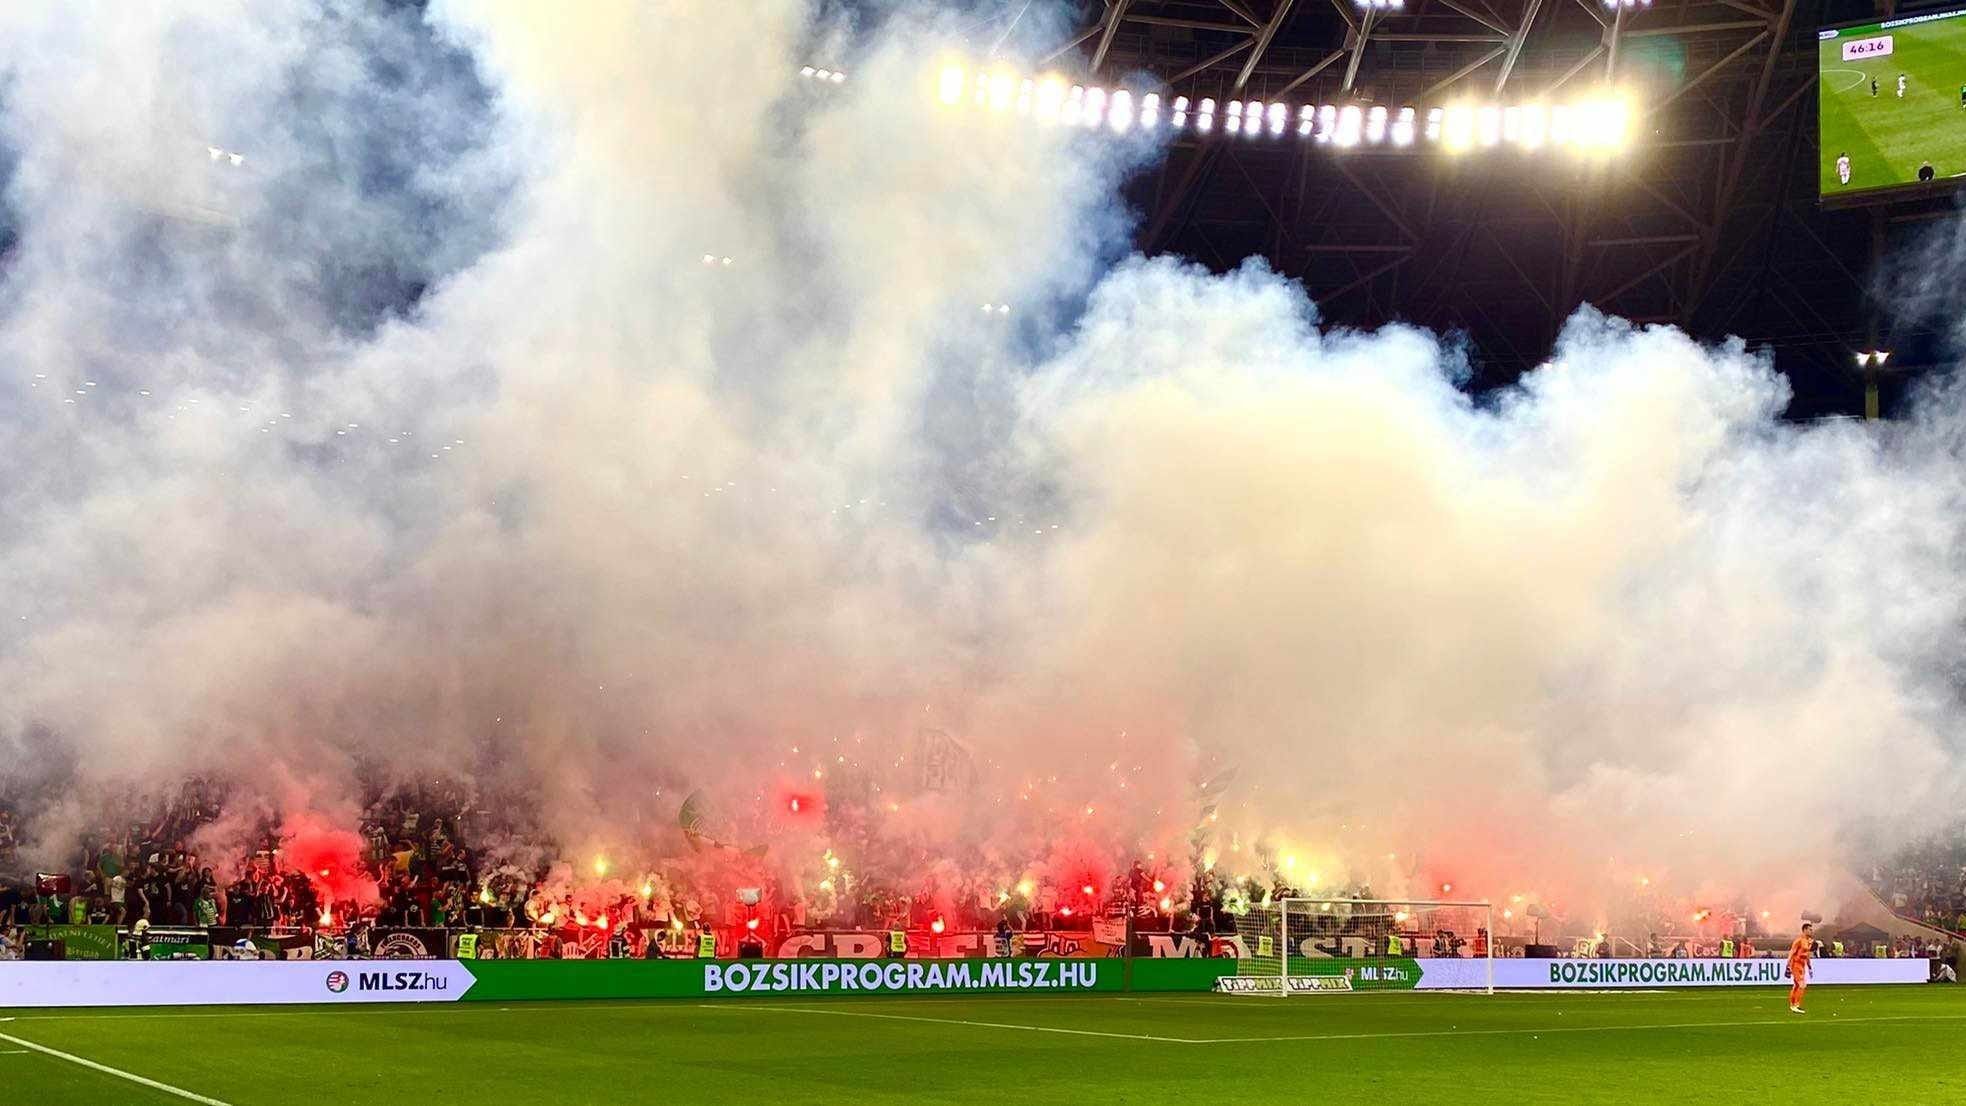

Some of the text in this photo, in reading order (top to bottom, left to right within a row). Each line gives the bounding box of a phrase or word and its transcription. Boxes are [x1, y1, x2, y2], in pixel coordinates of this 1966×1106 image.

[1849, 41, 1884, 54] 46:16
[359, 972, 447, 990] MLSZ.hu
[704, 963, 1097, 991] BOZSIKPROGRAM.MLSZ.HU
[1550, 962, 1780, 982] BOZSIKPROGRAM.MLSZ.HU
